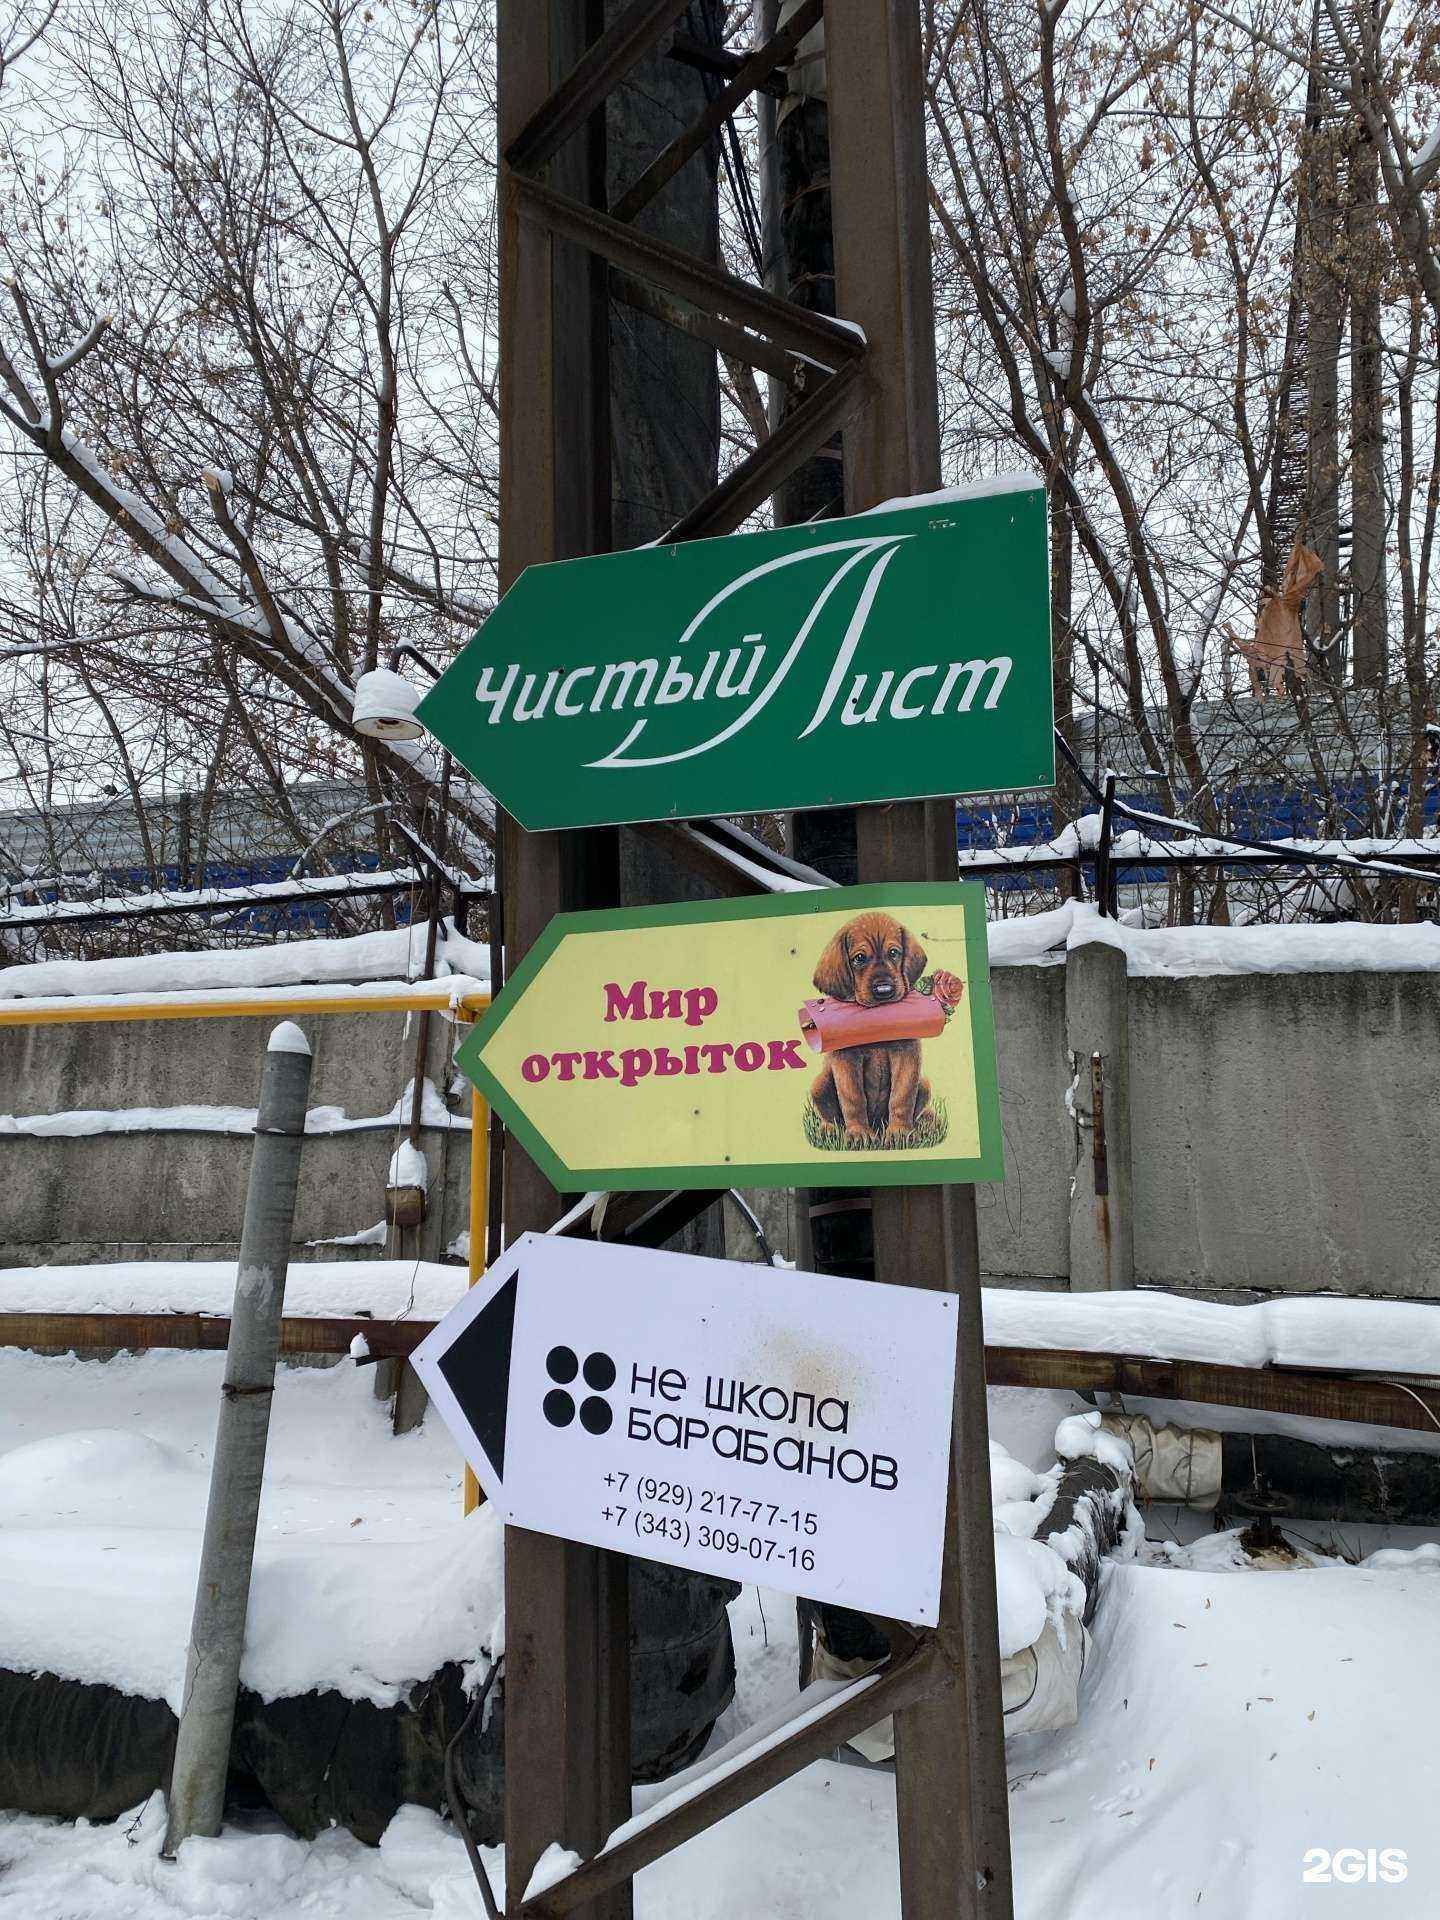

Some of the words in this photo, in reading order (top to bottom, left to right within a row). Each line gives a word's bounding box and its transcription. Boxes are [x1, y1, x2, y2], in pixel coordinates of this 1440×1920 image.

[475, 633, 767, 725] Чистый
[681, 533, 1013, 745] Лист
[602, 980, 719, 1027] Мир
[520, 1039, 808, 1088] открыток
[602, 1471, 630, 1493] +7
[637, 1476, 693, 1514] (929)
[699, 1489, 818, 1536] 217-77-15
[600, 1505, 628, 1527] +7
[634, 1509, 691, 1548] (343)
[697, 1524, 815, 1572] 309-07-16
